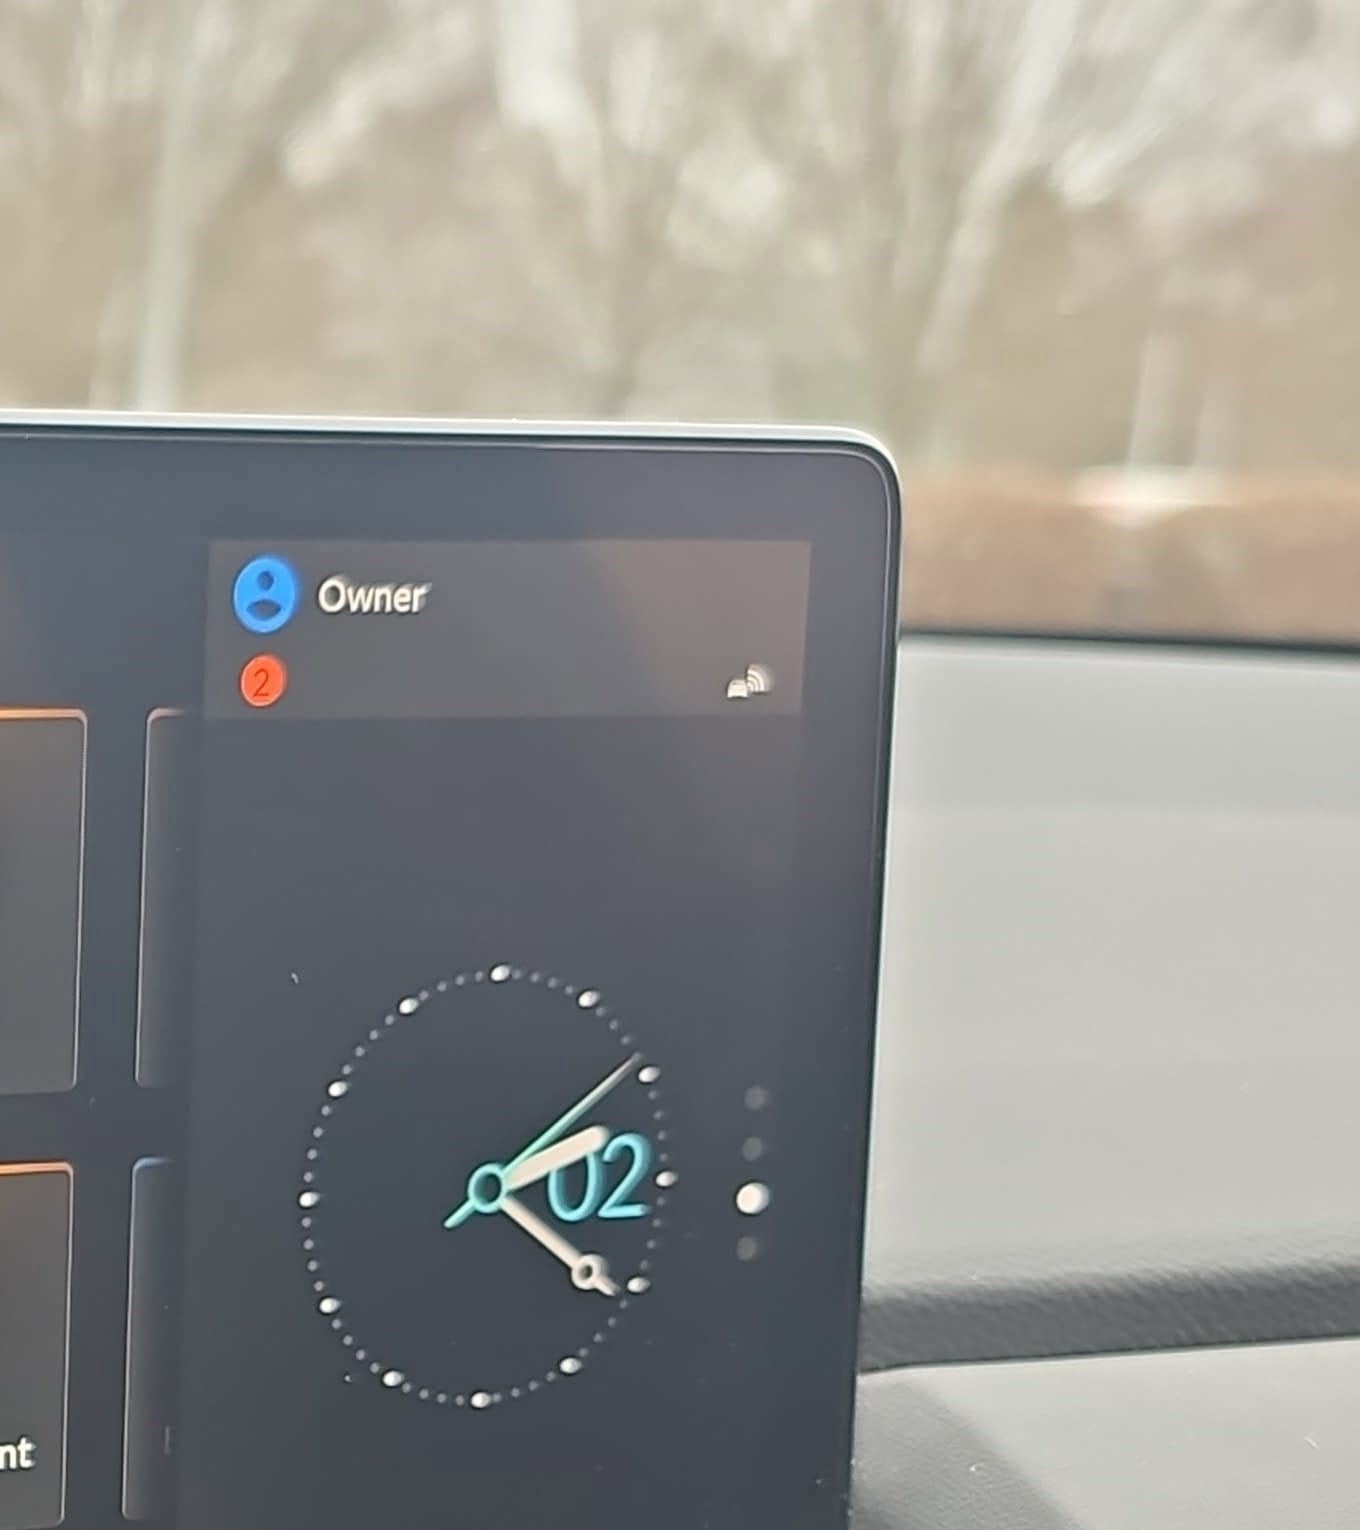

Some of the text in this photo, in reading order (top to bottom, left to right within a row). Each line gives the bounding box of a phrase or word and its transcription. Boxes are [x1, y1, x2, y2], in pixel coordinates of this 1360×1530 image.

[317, 574, 431, 614] Owner
[252, 667, 270, 698] 2
[547, 1132, 652, 1222] 02
